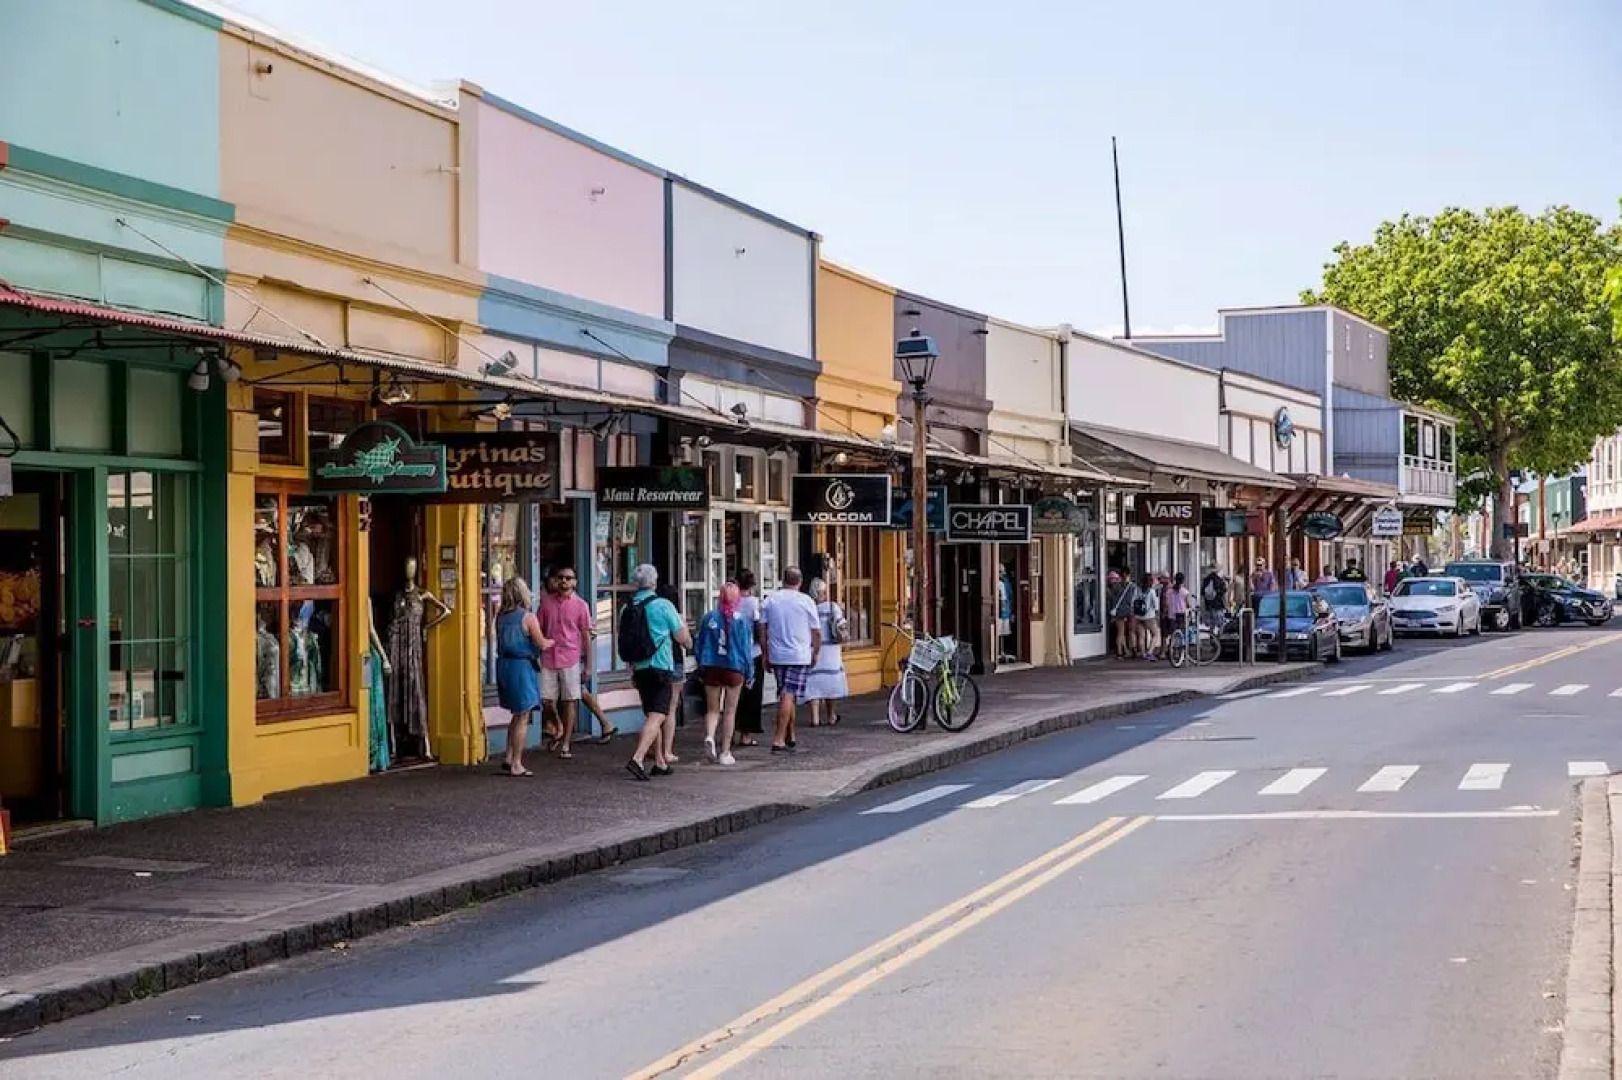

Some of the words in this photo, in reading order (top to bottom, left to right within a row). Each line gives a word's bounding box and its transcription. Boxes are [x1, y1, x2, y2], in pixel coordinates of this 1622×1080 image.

[446, 441, 546, 471] rina's
[637, 487, 703, 502] Resortwear
[807, 511, 872, 522] VOLCOM
[1146, 500, 1193, 519] VANS
[952, 510, 1026, 530] CHAPEL
